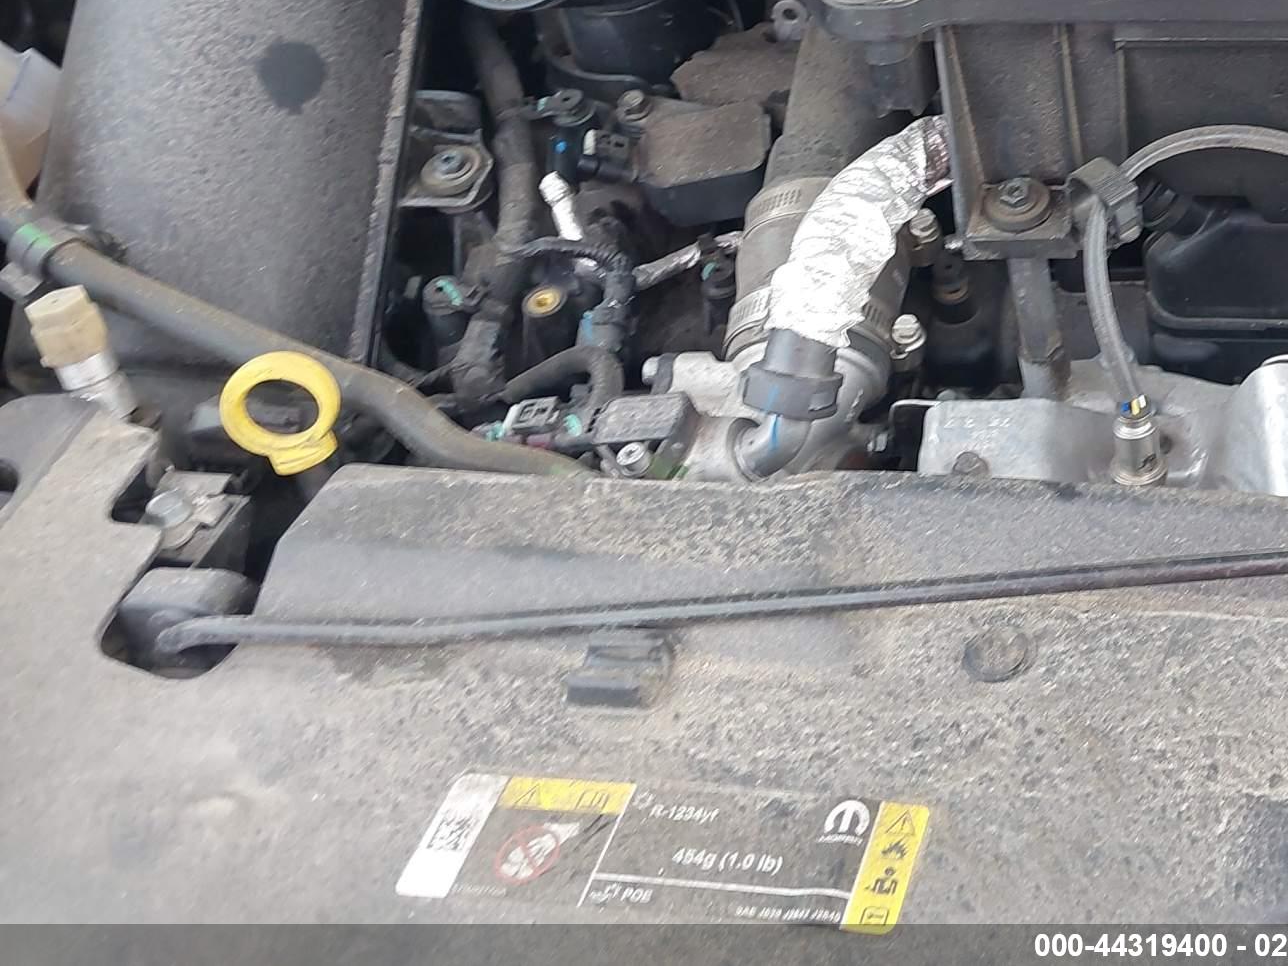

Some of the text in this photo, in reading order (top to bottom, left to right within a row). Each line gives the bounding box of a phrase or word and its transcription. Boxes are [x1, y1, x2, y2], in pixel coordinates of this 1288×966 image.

[648, 803, 720, 825] R-1234yf
[671, 847, 784, 876] 454g (1.0 lb)
